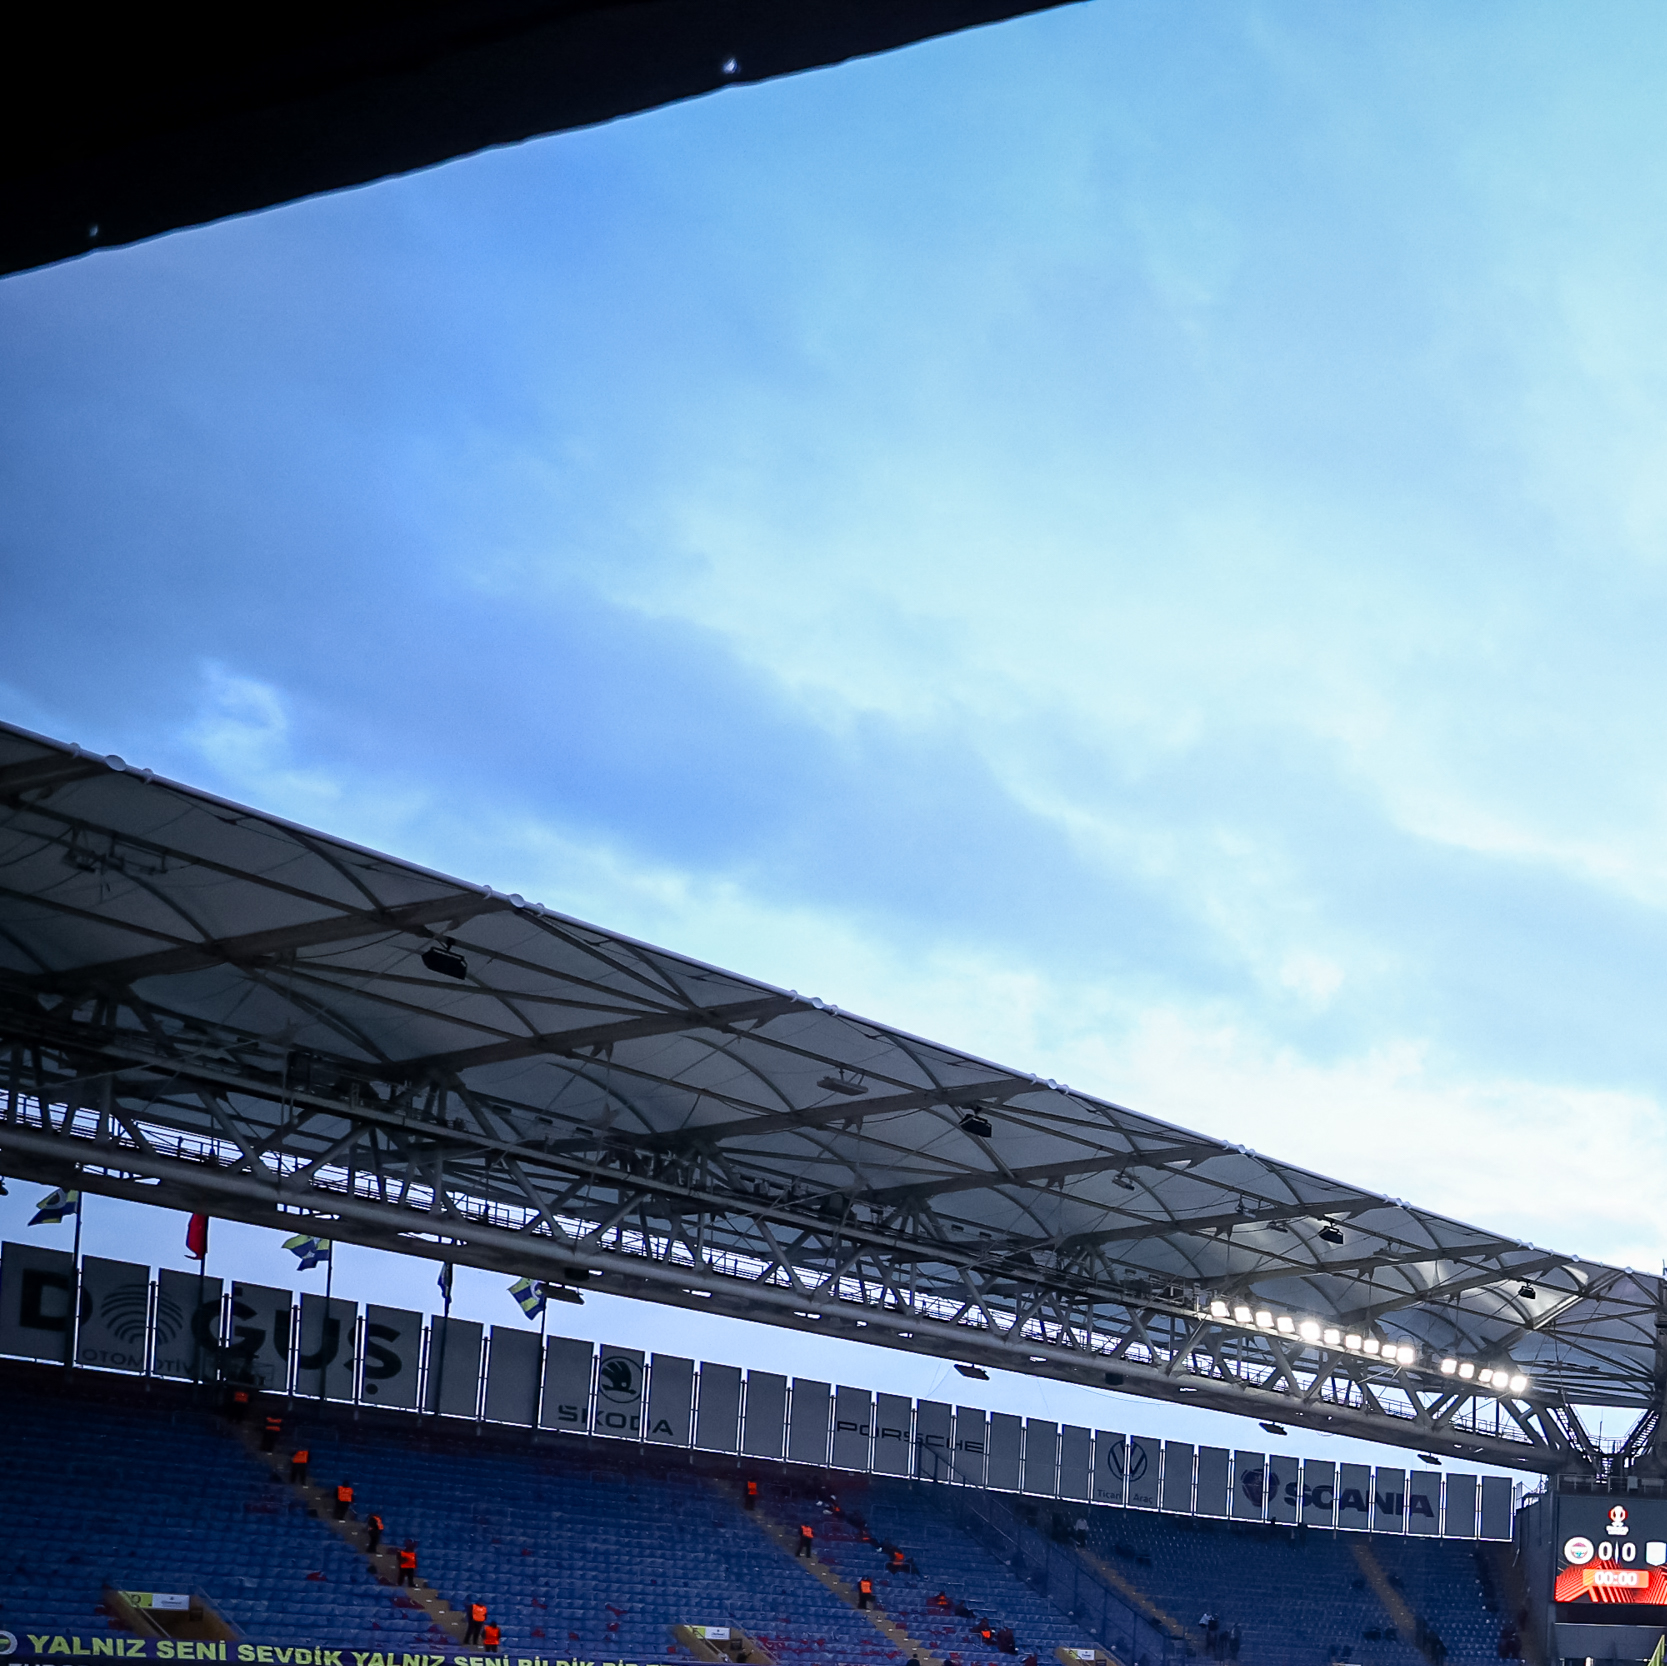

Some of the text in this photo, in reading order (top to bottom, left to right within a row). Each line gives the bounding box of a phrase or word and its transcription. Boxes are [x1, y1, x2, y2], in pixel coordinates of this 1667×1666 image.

[1284, 1481, 1435, 1518] SCANIA
[1598, 1541, 1636, 1562] 0 0
[1594, 1571, 1637, 1586] 00:00
[27, 1634, 147, 1658] YALNIZ
[156, 1640, 227, 1662] SENİ
[237, 1646, 343, 1666] SEVDİK
